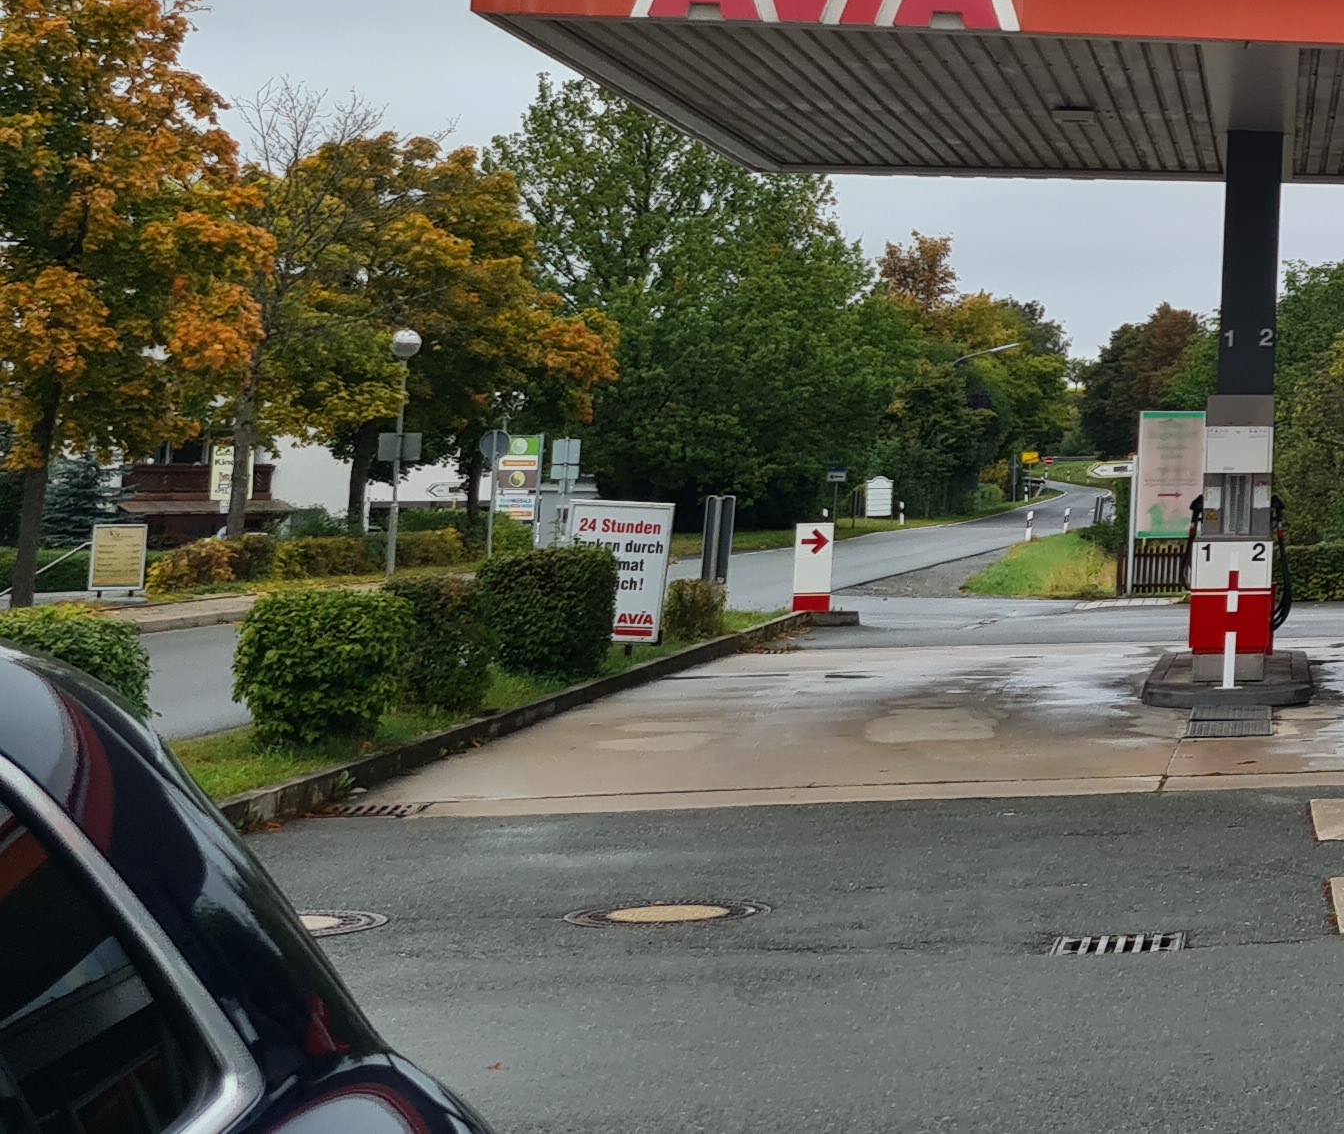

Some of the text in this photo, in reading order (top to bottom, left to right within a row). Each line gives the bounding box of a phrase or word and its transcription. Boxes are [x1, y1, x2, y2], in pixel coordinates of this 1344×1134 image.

[1224, 328, 1274, 347] 1 2
[580, 518, 662, 534] 24 Stunden
[625, 540, 664, 554] durch
[1202, 543, 1266, 562] 1 2
[617, 611, 654, 625] AVIA
